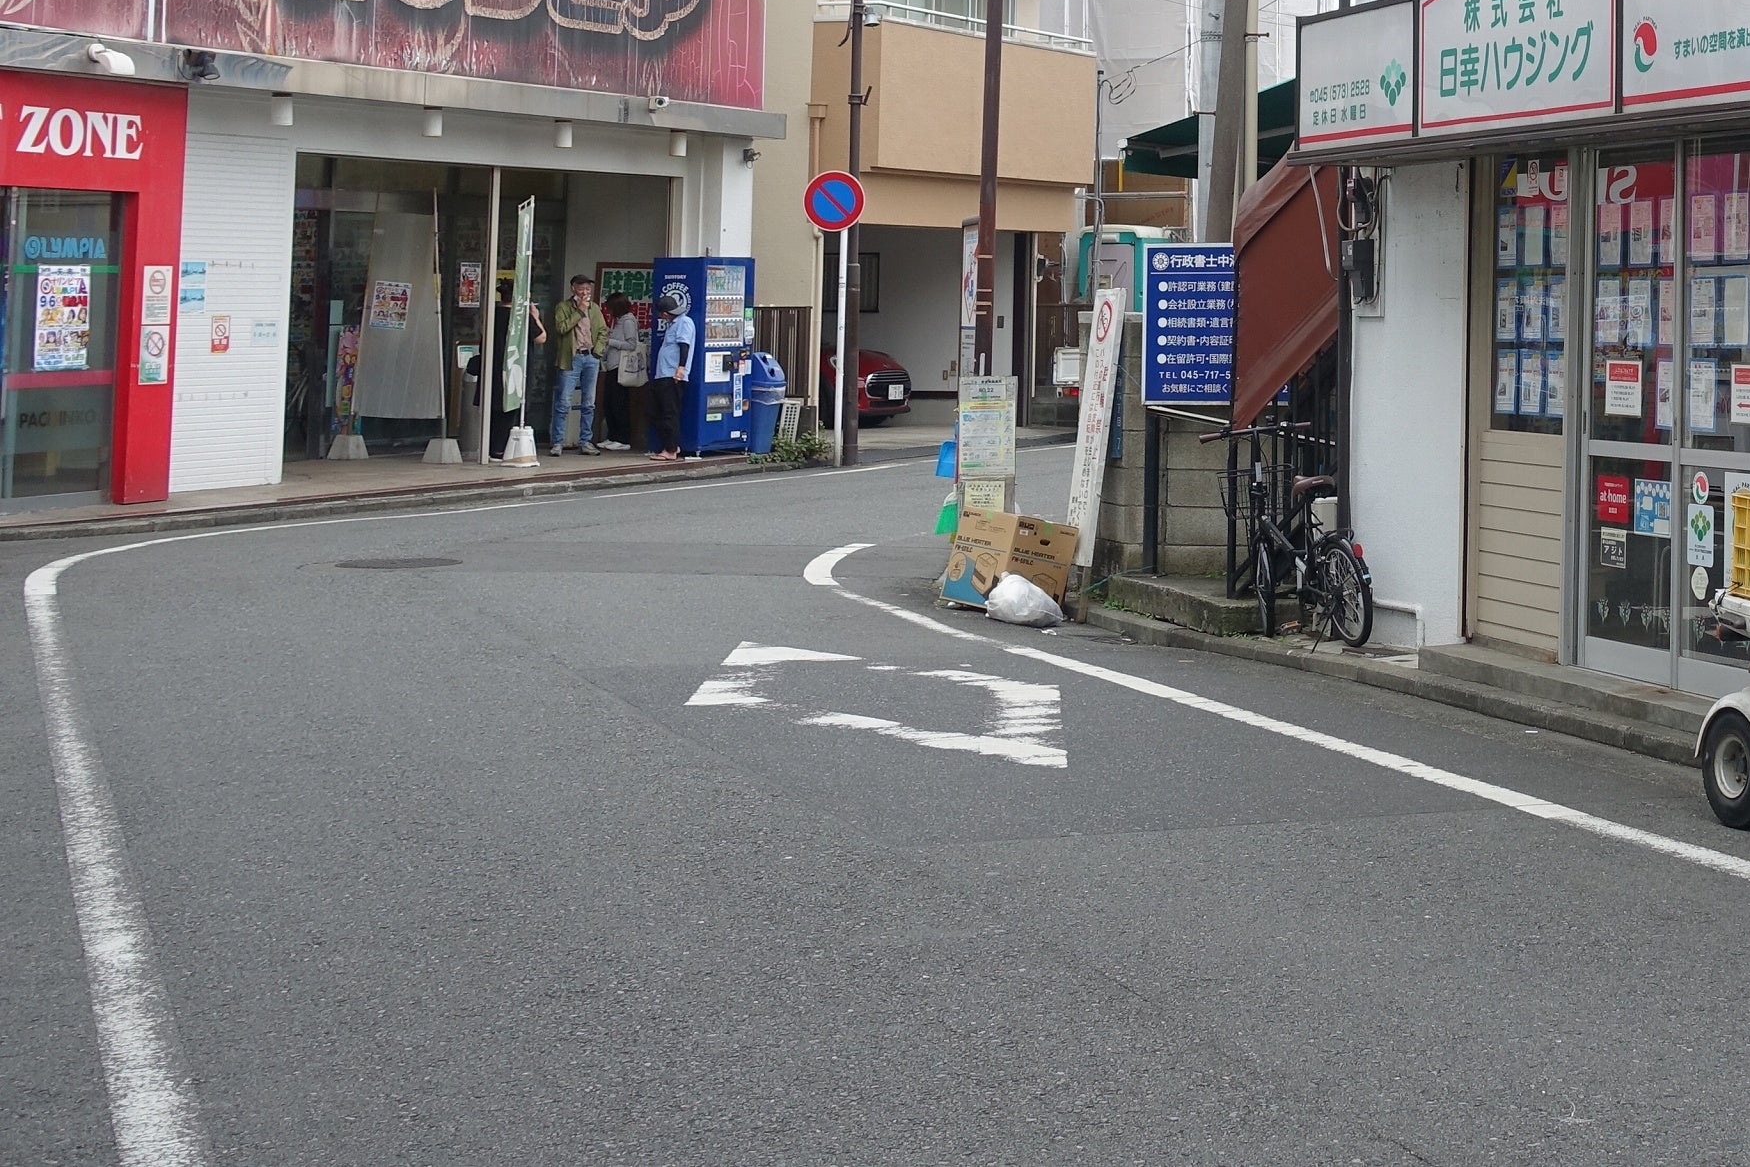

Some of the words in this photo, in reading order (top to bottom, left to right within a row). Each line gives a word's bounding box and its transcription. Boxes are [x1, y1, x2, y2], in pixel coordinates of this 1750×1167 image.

[1440, 20, 1594, 97] 日幸ハウジング
[16, 105, 144, 160] ZONE
[24, 235, 107, 260] OLYMPIA
[662, 282, 689, 293] COFFEE
[1181, 371, 1231, 379] 045-717-5
[1162, 384, 1231, 394] お気軽にご相談く
